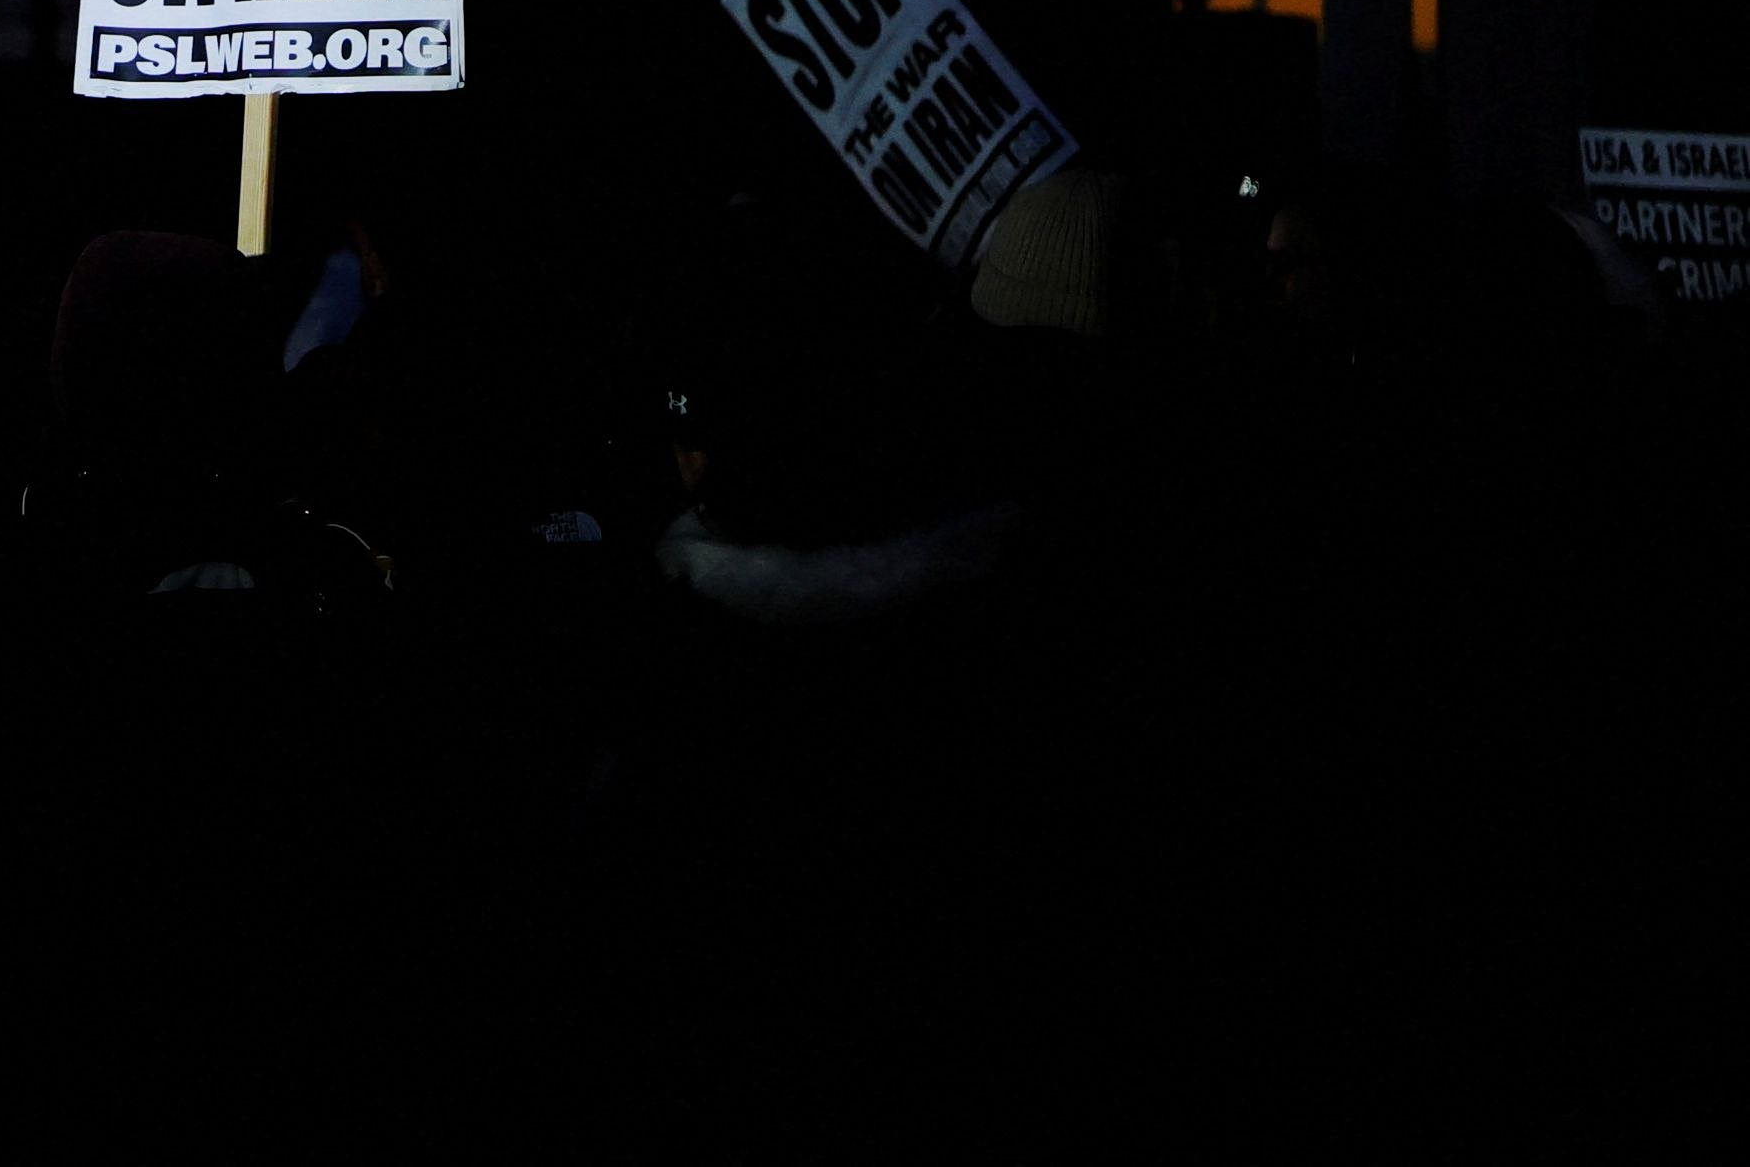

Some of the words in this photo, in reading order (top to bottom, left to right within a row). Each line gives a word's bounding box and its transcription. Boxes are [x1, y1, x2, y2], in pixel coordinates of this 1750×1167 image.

[96, 26, 451, 77] PSLWEB.ORG
[844, 94, 896, 165] THE
[885, 9, 967, 102] WAR
[903, 44, 1021, 189] IRAN
[1585, 139, 1635, 173] USA
[1643, 139, 1659, 173] &
[871, 142, 943, 234] ON
[1594, 196, 1750, 248] PARTNER
[1658, 255, 1750, 301] RIM
